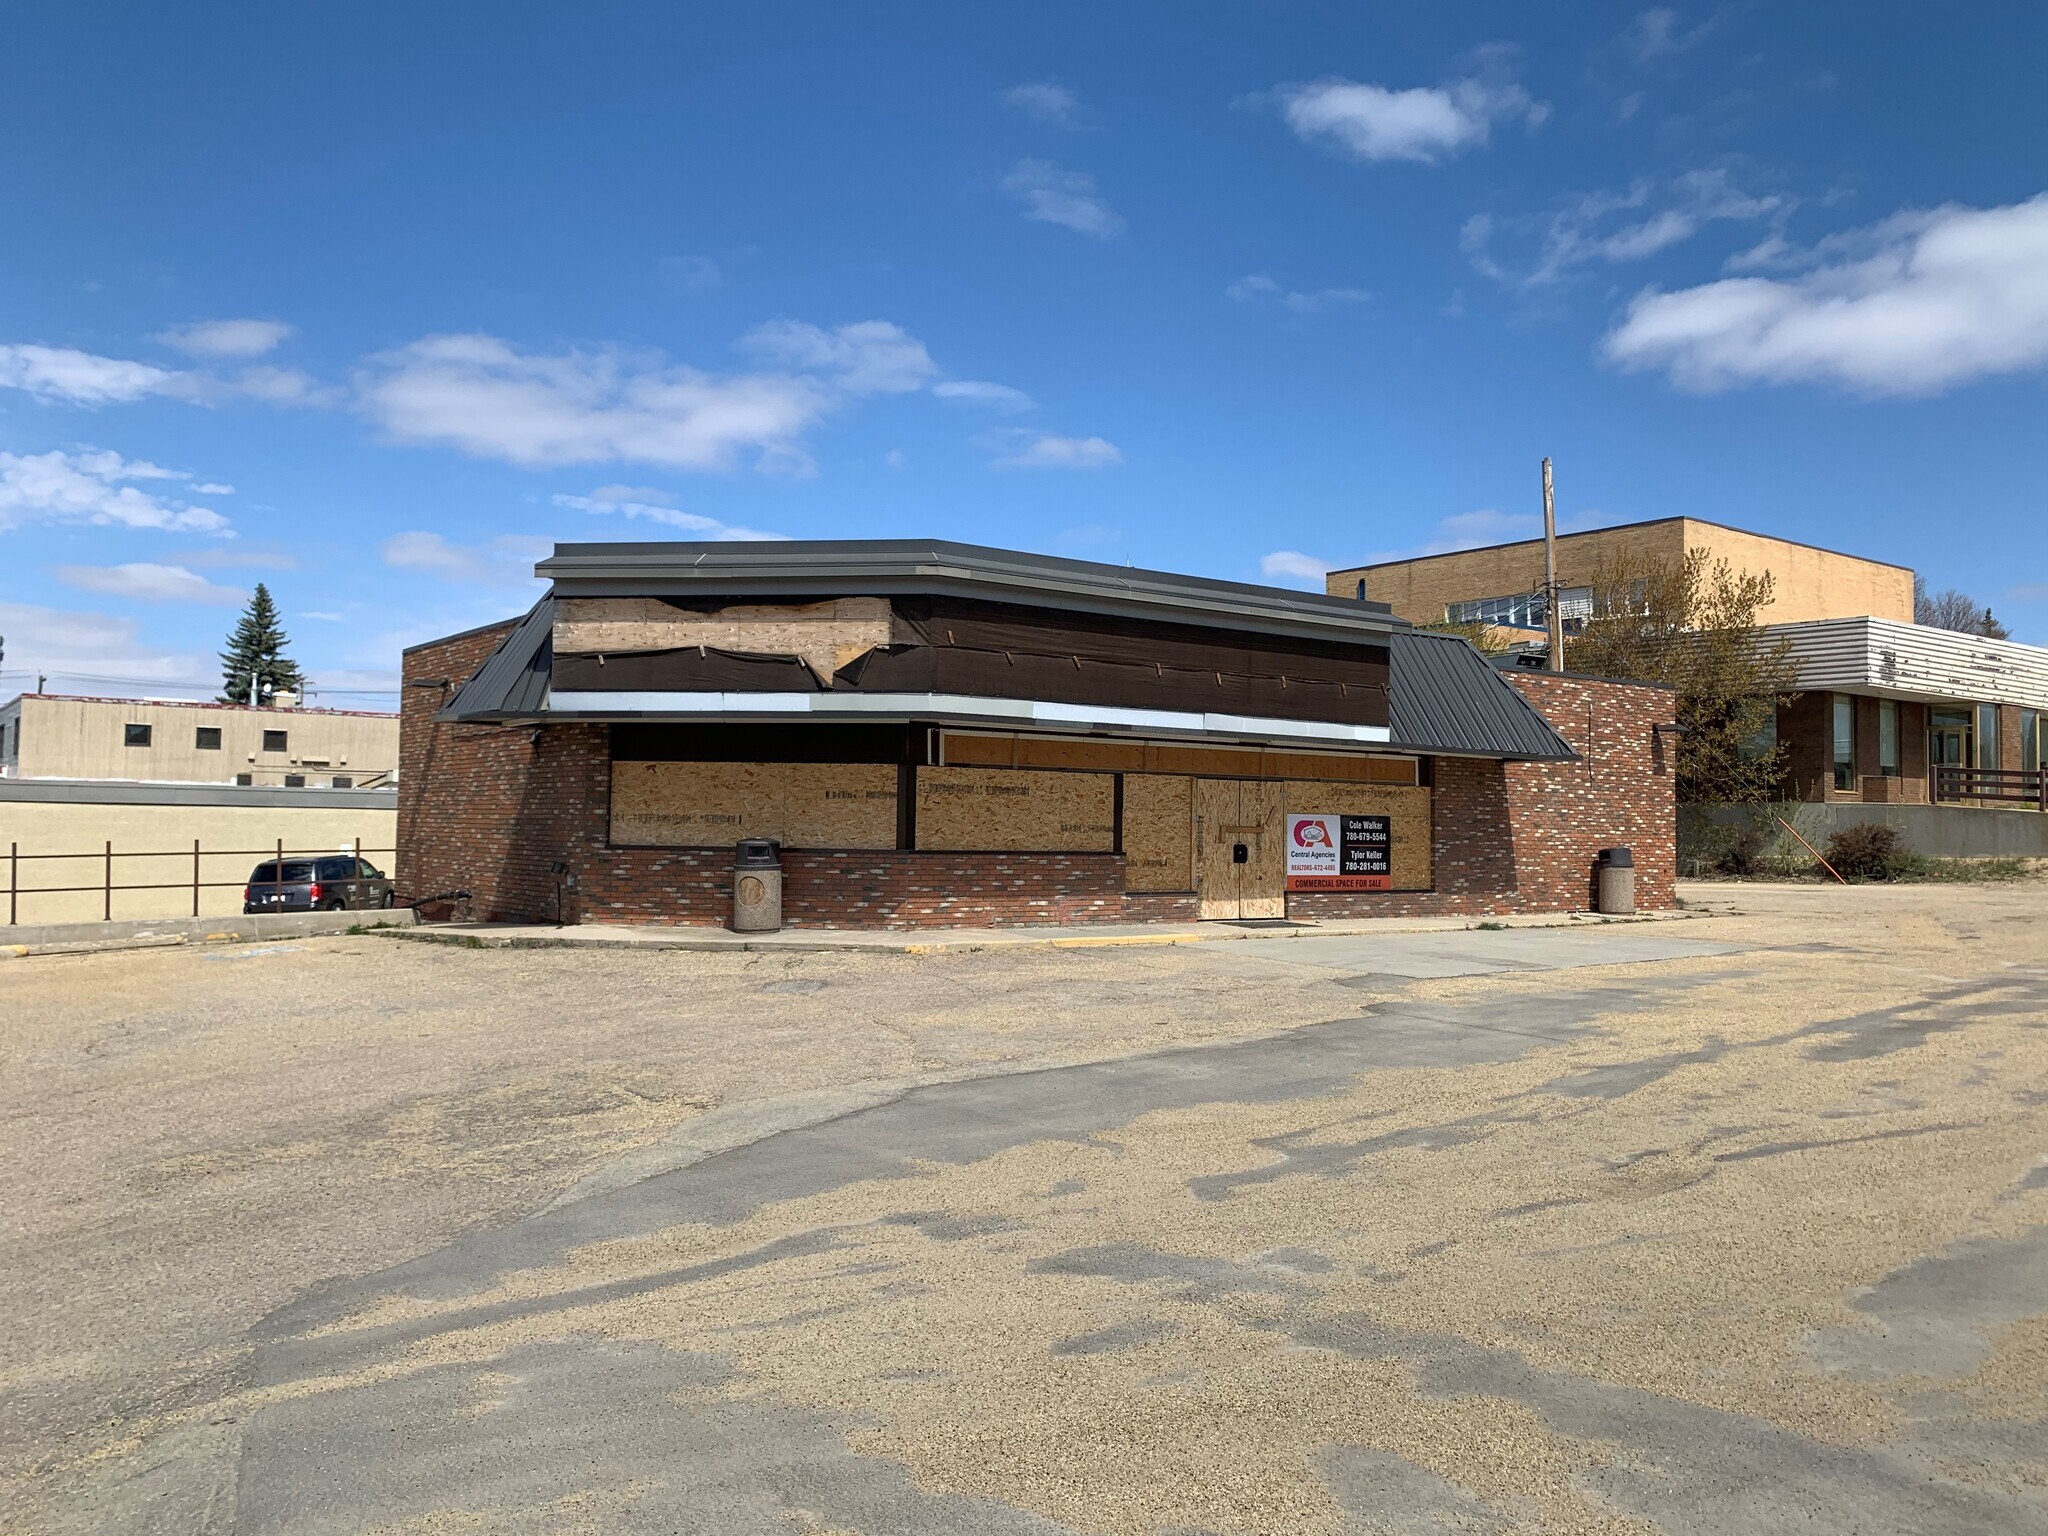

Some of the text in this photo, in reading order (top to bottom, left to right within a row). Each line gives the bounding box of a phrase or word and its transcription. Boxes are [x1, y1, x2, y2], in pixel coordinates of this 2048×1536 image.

[1349, 820, 1382, 830] Cole Walker
[1346, 832, 1386, 841] 780-679-5544
[1311, 851, 1336, 859] Agencies
[1366, 851, 1382, 859] Keller
[1346, 862, 1386, 870] 780-281-0016
[1295, 879, 1382, 888] COMMERCIAL SPACE FOR SALE
